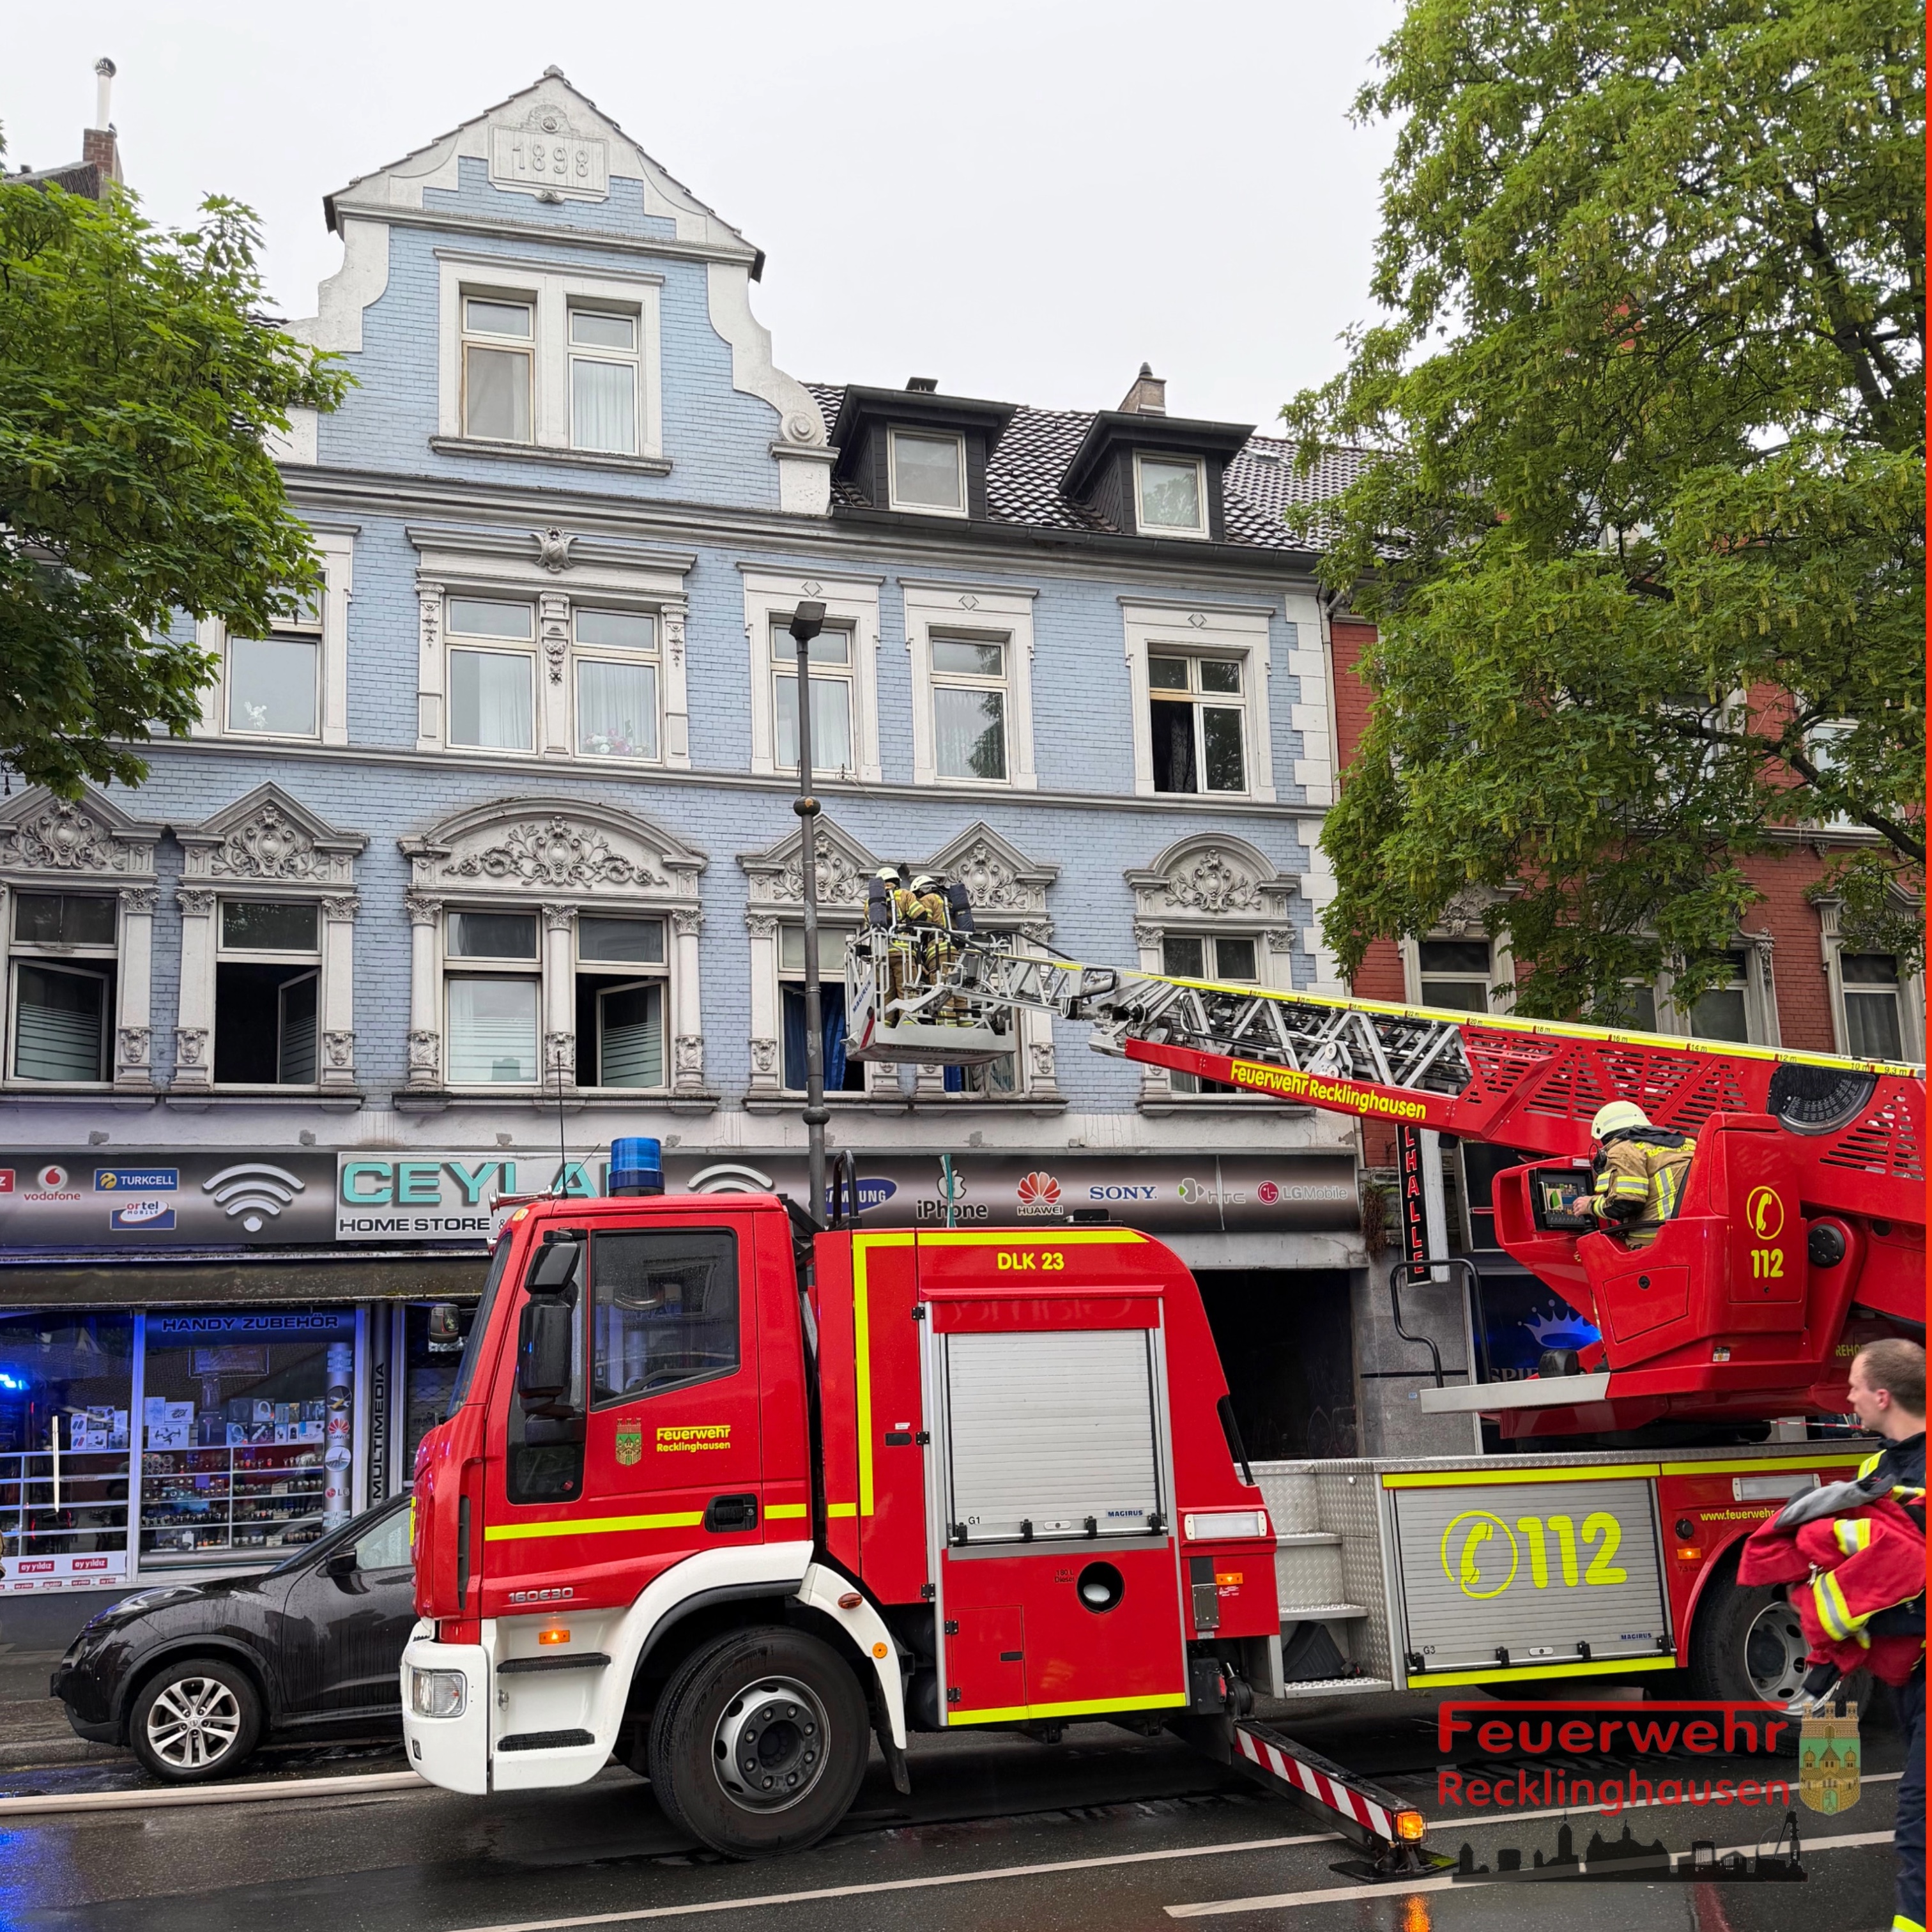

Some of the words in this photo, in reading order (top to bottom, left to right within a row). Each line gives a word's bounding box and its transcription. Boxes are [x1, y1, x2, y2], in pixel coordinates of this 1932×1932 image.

[512, 143, 589, 178] 1898
[1885, 1066, 1897, 1075] 9,3
[1230, 1060, 1309, 1094] Feuerwehr
[1309, 1079, 1427, 1119] Recklinghausen
[120, 1176, 174, 1185] TURKCELL
[342, 1162, 612, 1204] CEYLA
[24, 1191, 81, 1200] vodafone
[127, 1201, 158, 1210] ortel
[1018, 1206, 1062, 1215] HUAWEI
[339, 1218, 409, 1232] HOME
[414, 1217, 491, 1232] STORE
[997, 1253, 1036, 1270] DLK
[1041, 1252, 1064, 1270] 23
[1751, 1248, 1784, 1278] 112
[162, 1318, 235, 1331] HANDY
[241, 1312, 339, 1330] ZUBEHÖR
[372, 1362, 385, 1499] MULTIMEDIA
[656, 1425, 731, 1441] Feuerwehr
[656, 1441, 731, 1452] Recklinghausen
[968, 1516, 981, 1524] G1
[1516, 1512, 1628, 1589] 112
[1423, 1646, 1436, 1654] G3
